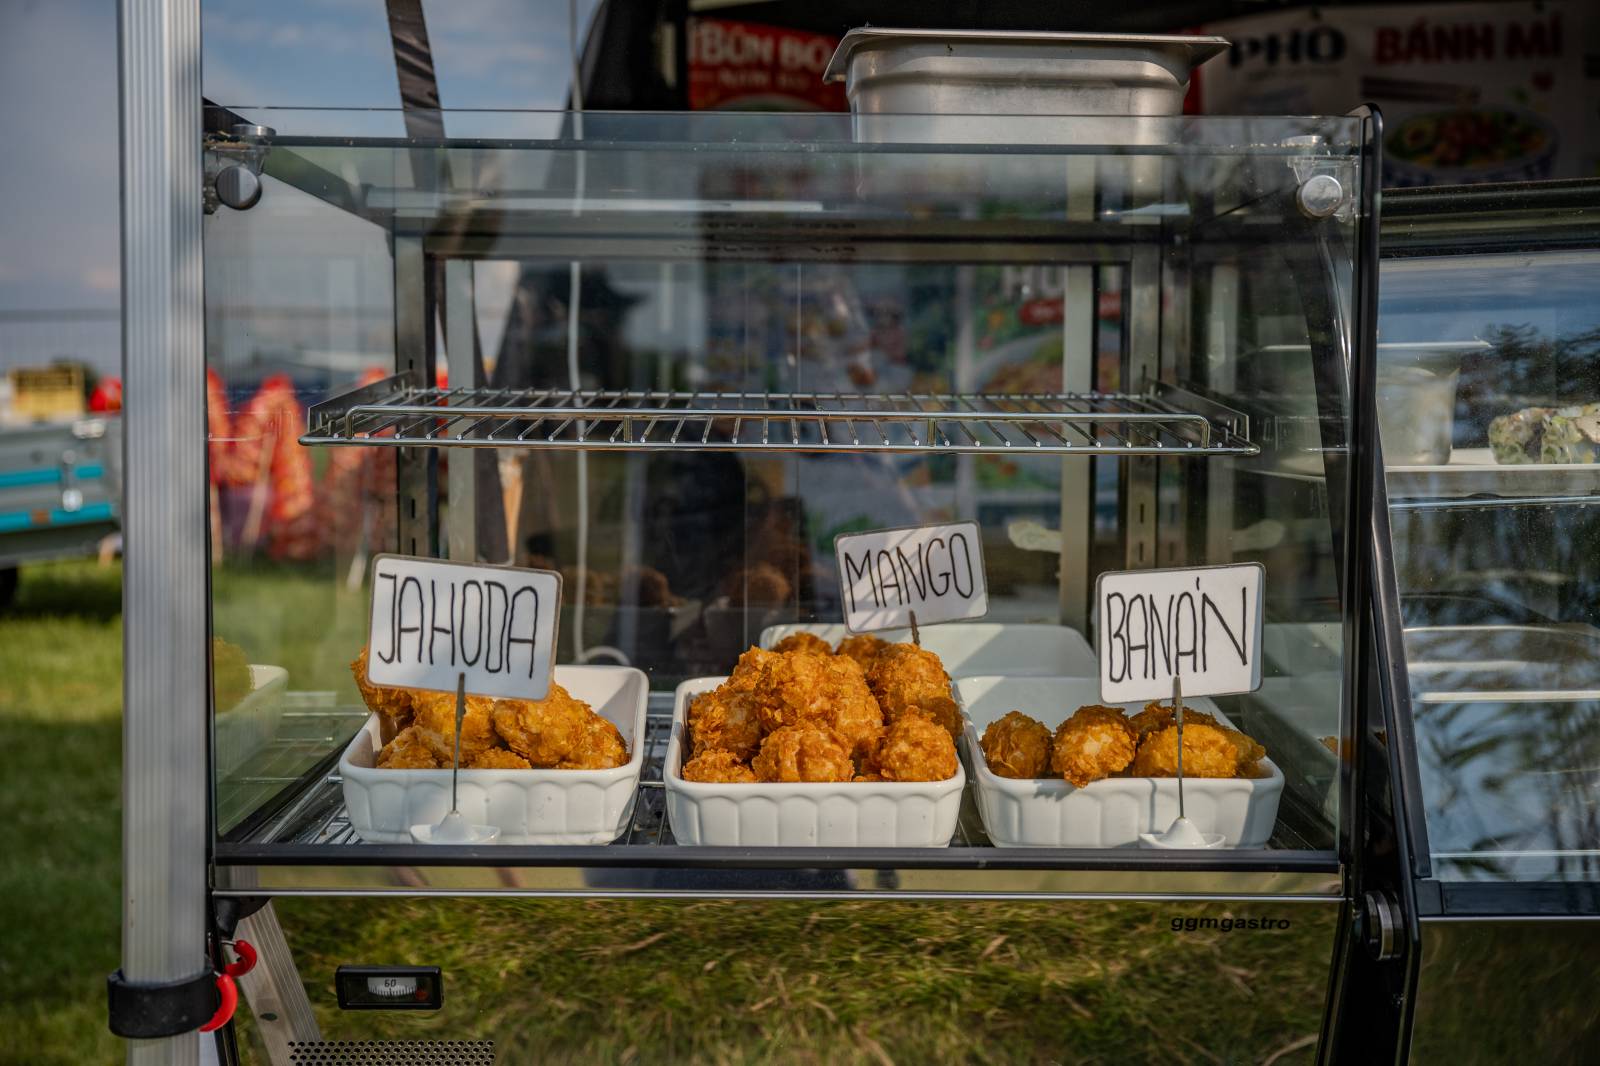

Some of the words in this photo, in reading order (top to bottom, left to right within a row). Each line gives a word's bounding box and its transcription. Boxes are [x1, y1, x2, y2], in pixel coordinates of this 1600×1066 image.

[1374, 18, 1494, 64] BÁNH
[844, 532, 974, 613] MANGO
[378, 572, 539, 680] JAHODA
[1106, 576, 1248, 683] BANÁN
[1171, 916, 1290, 932] ggmgastro
